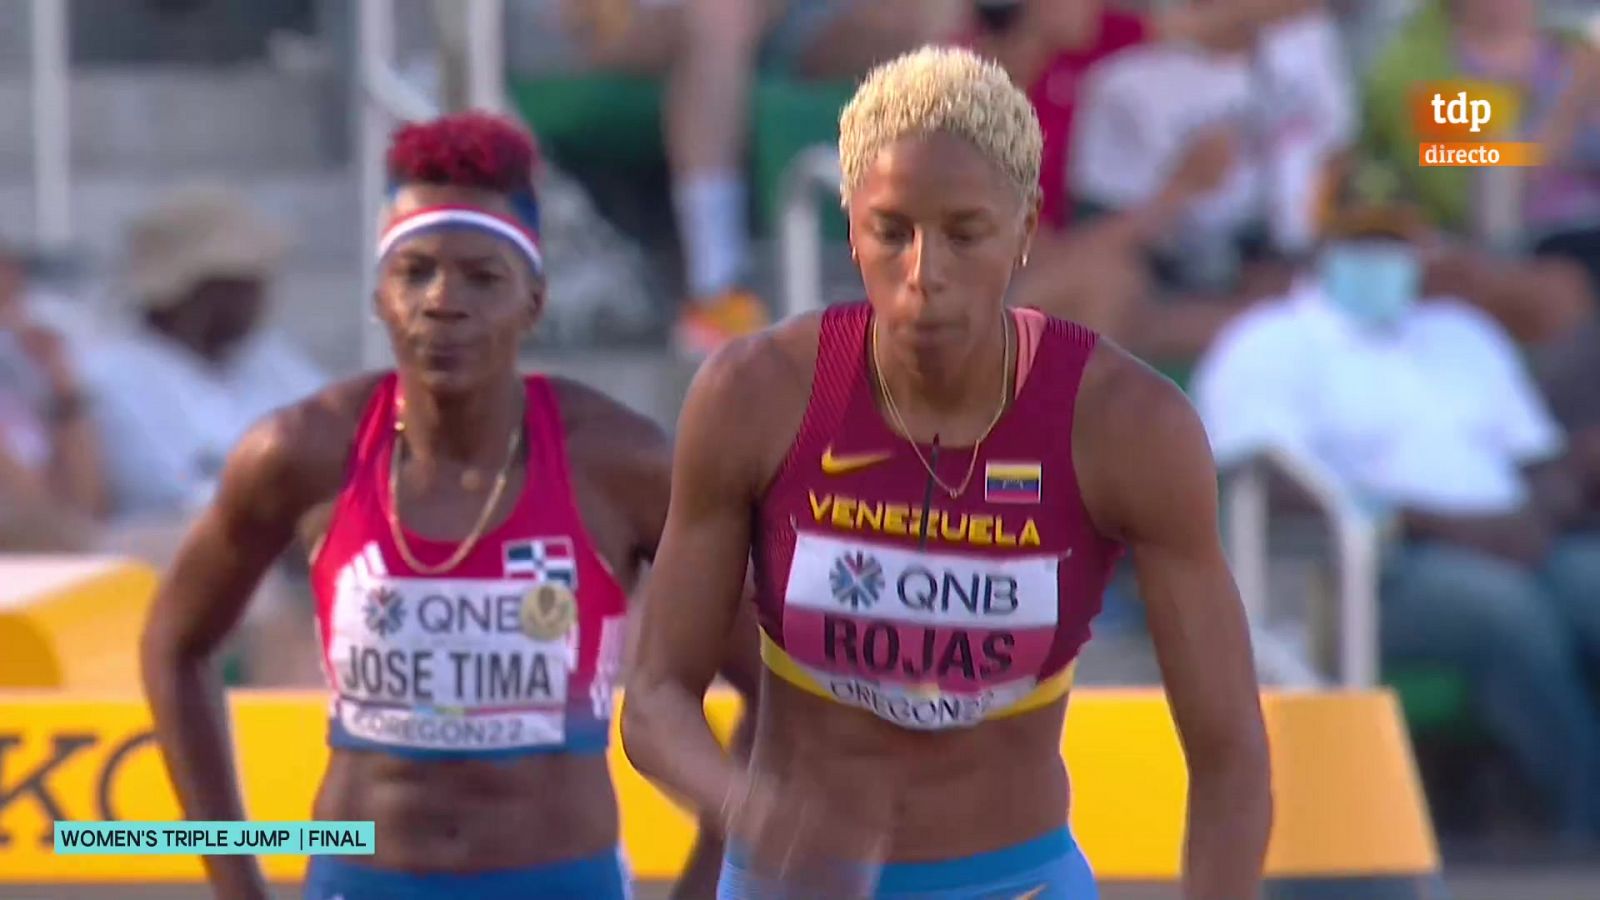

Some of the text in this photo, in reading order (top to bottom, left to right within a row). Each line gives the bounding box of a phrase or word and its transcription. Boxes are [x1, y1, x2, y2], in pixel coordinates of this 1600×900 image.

[808, 490, 1041, 546] VENEZUELA
[896, 565, 1019, 615] QNB
[343, 645, 552, 702] JOSE TIMA
[823, 612, 1016, 681] ROJAS
